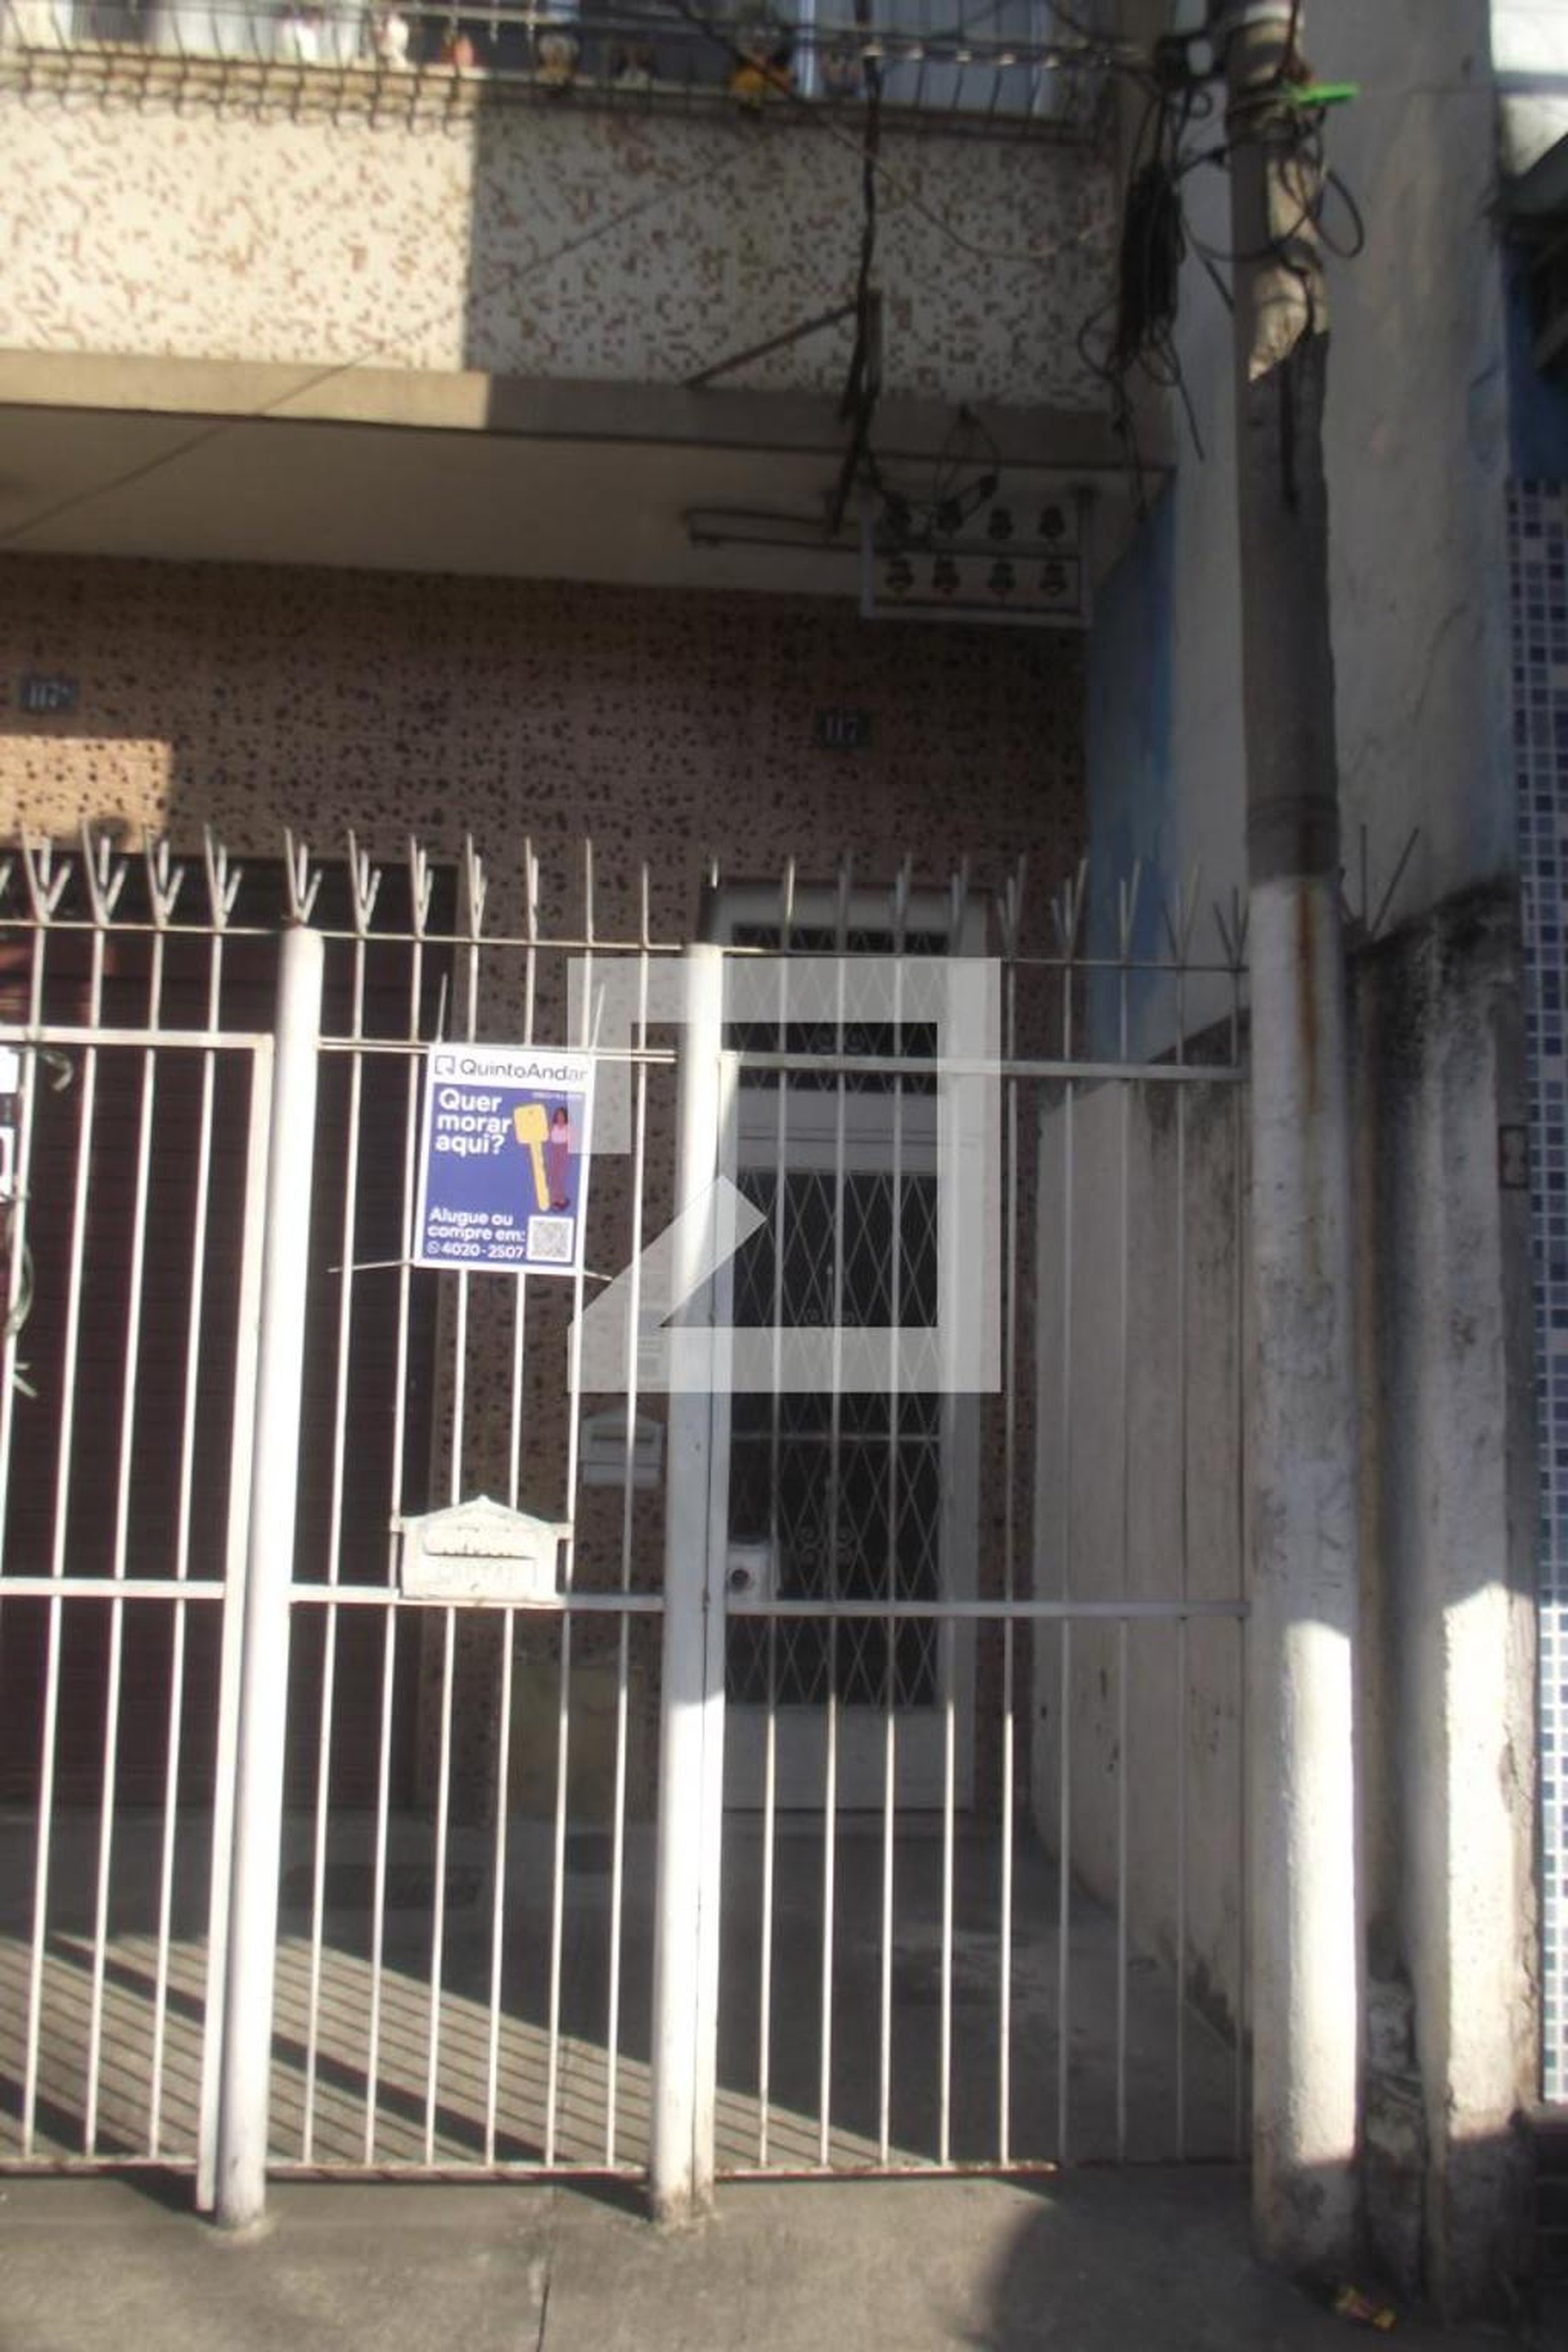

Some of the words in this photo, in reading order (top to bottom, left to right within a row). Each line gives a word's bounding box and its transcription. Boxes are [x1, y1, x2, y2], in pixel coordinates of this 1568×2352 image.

[460, 1058, 587, 1081] QuintoAndar
[439, 1088, 502, 1112] Quer
[437, 1114, 512, 1134] morar
[435, 1133, 505, 1157] aqui?
[430, 1207, 488, 1227] Alugue
[491, 1213, 514, 1225] ou
[428, 1226, 493, 1242] compre
[495, 1229, 526, 1242] em:
